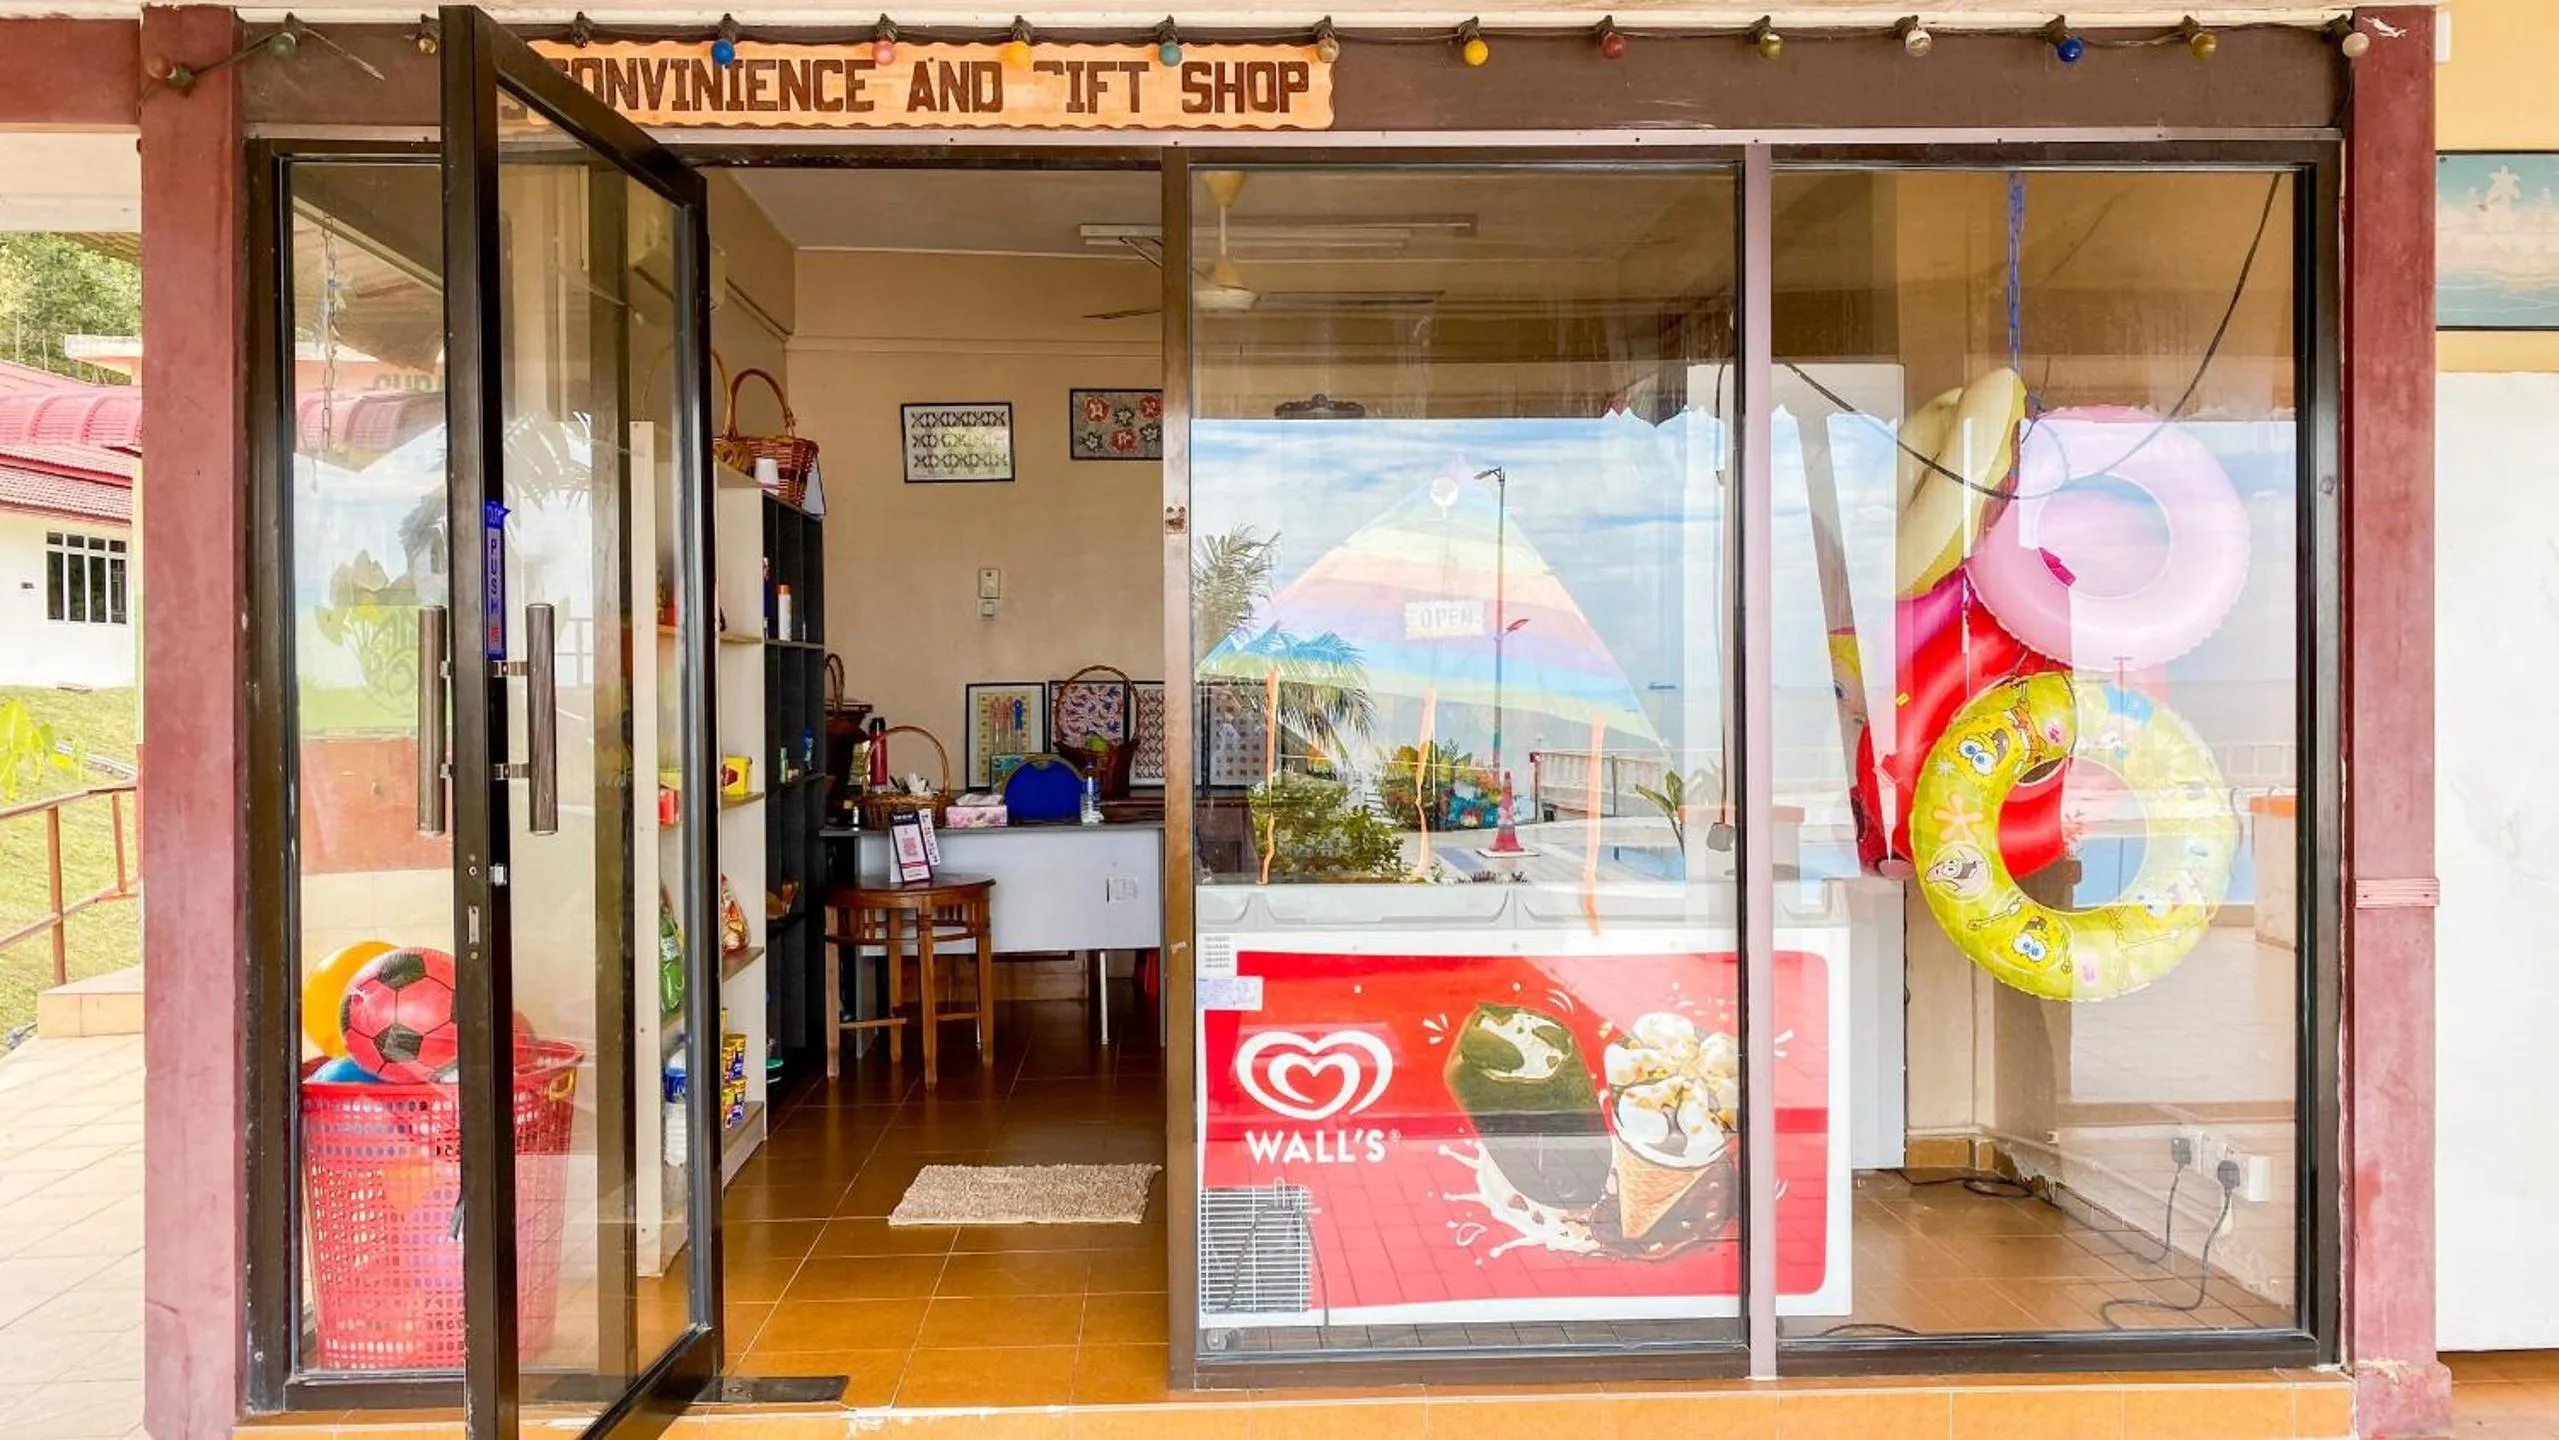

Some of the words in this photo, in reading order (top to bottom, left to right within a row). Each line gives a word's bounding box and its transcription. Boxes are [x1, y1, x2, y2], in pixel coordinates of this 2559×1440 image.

[547, 57, 875, 112] ONVINIENCE
[906, 60, 1003, 113] AND
[1033, 61, 1150, 113] IFT
[1181, 61, 1310, 114] SHOP
[1420, 607, 1474, 628] OPEN
